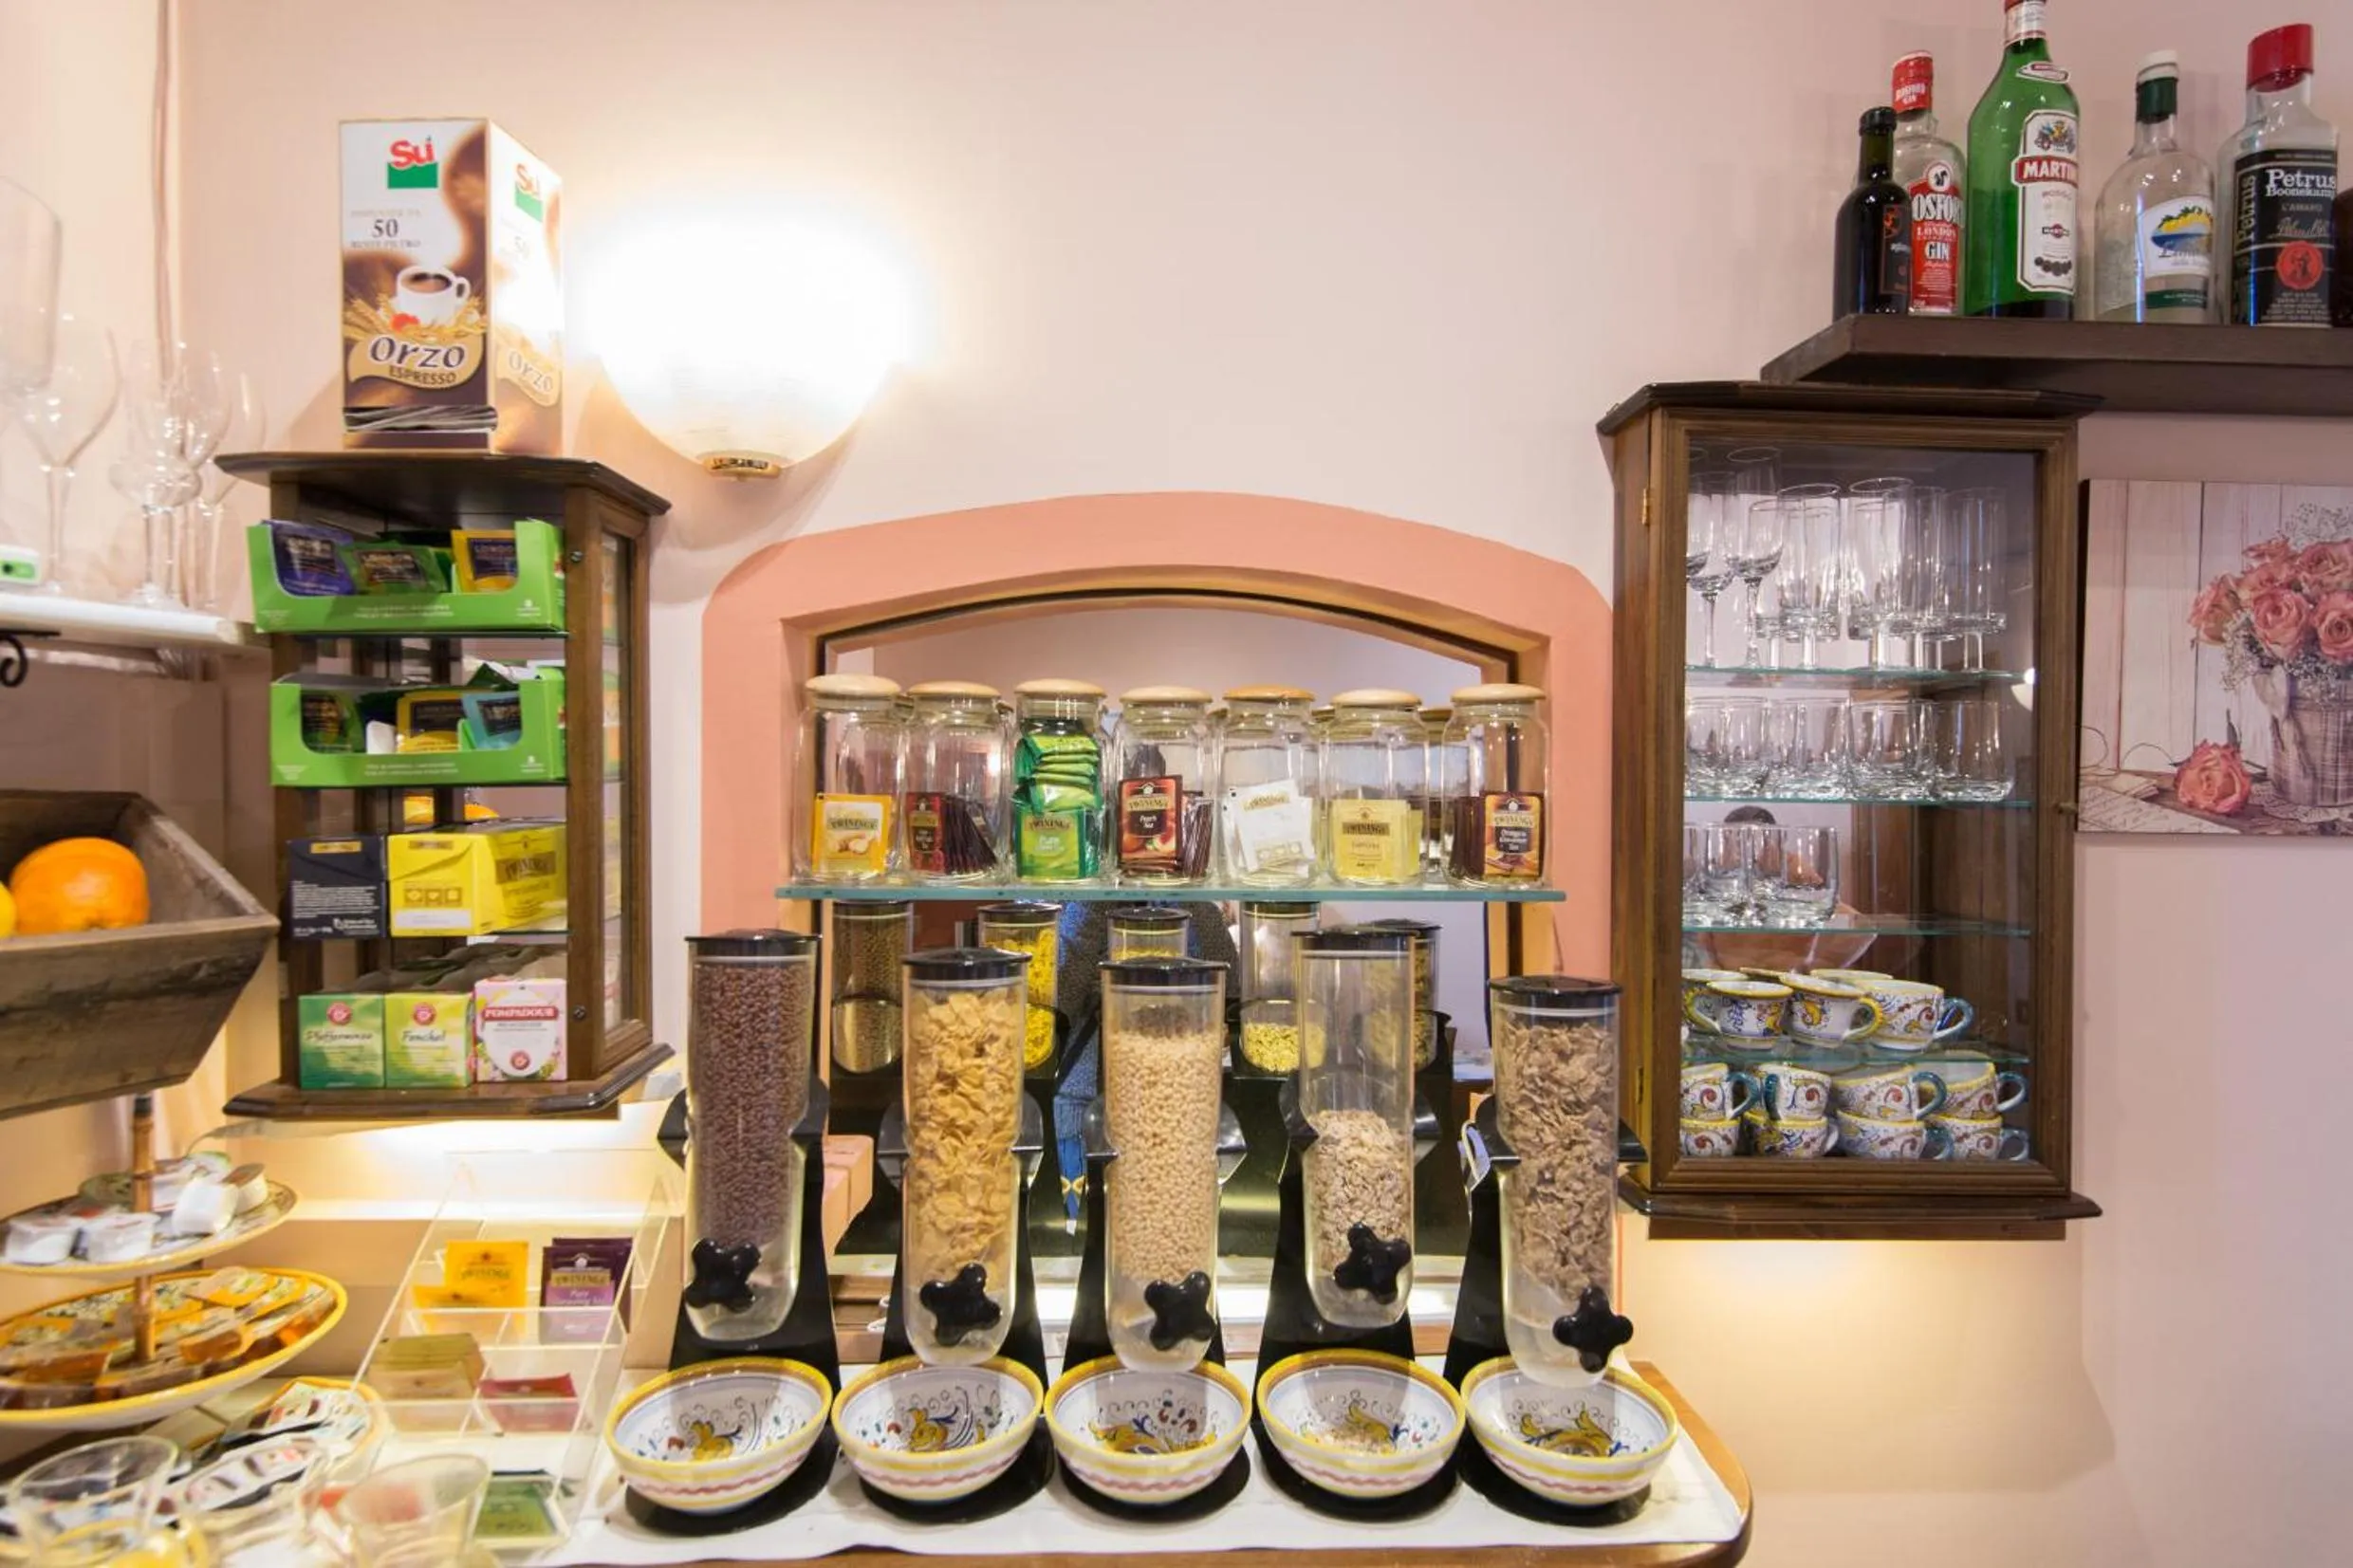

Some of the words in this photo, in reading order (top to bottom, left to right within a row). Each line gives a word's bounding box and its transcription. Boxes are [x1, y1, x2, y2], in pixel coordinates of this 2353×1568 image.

[2265, 168, 2337, 190] Petrus
[372, 218, 398, 238] 50
[1925, 241, 1950, 259] GIN
[371, 337, 465, 368] Orzo
